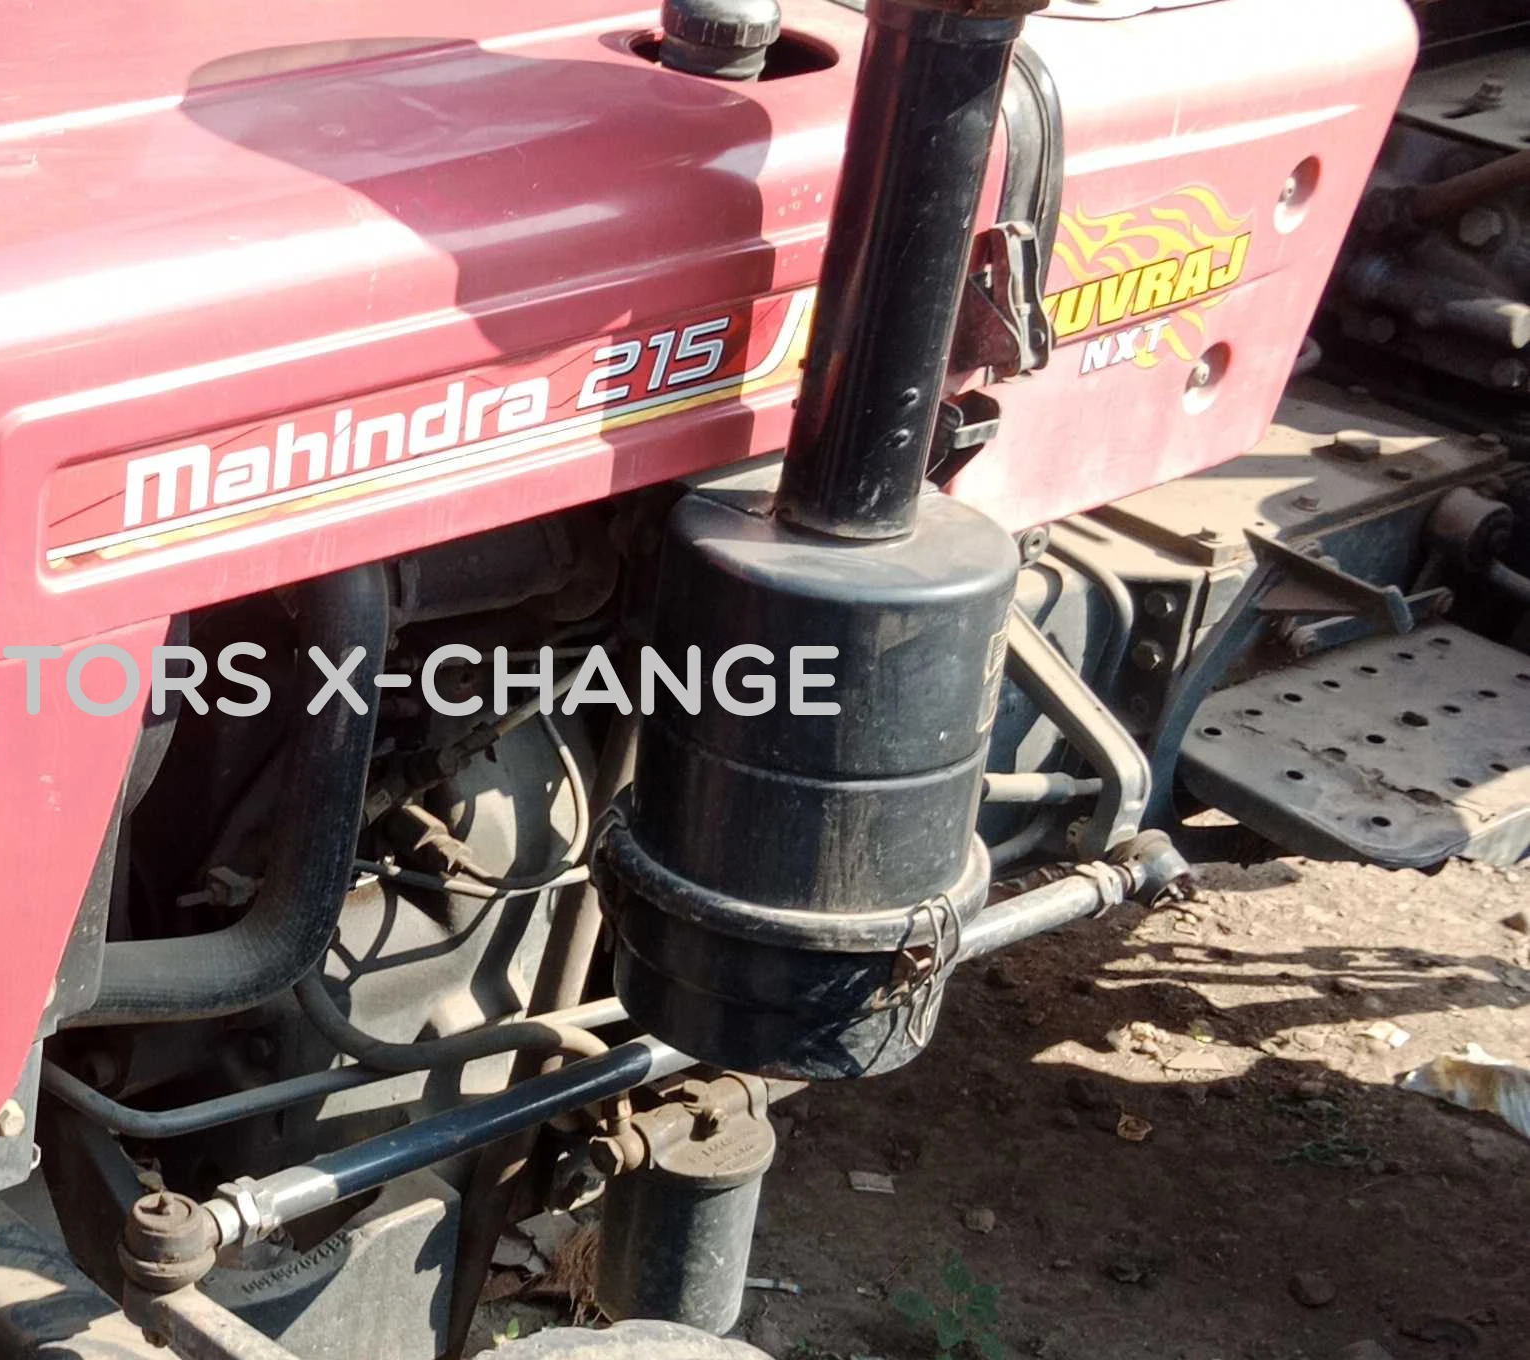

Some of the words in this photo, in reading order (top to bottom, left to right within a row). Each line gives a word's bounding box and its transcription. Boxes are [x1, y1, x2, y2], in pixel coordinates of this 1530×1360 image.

[1078, 317, 1170, 376] NXT
[123, 377, 549, 529] Mahindra
[576, 315, 732, 411] 215
